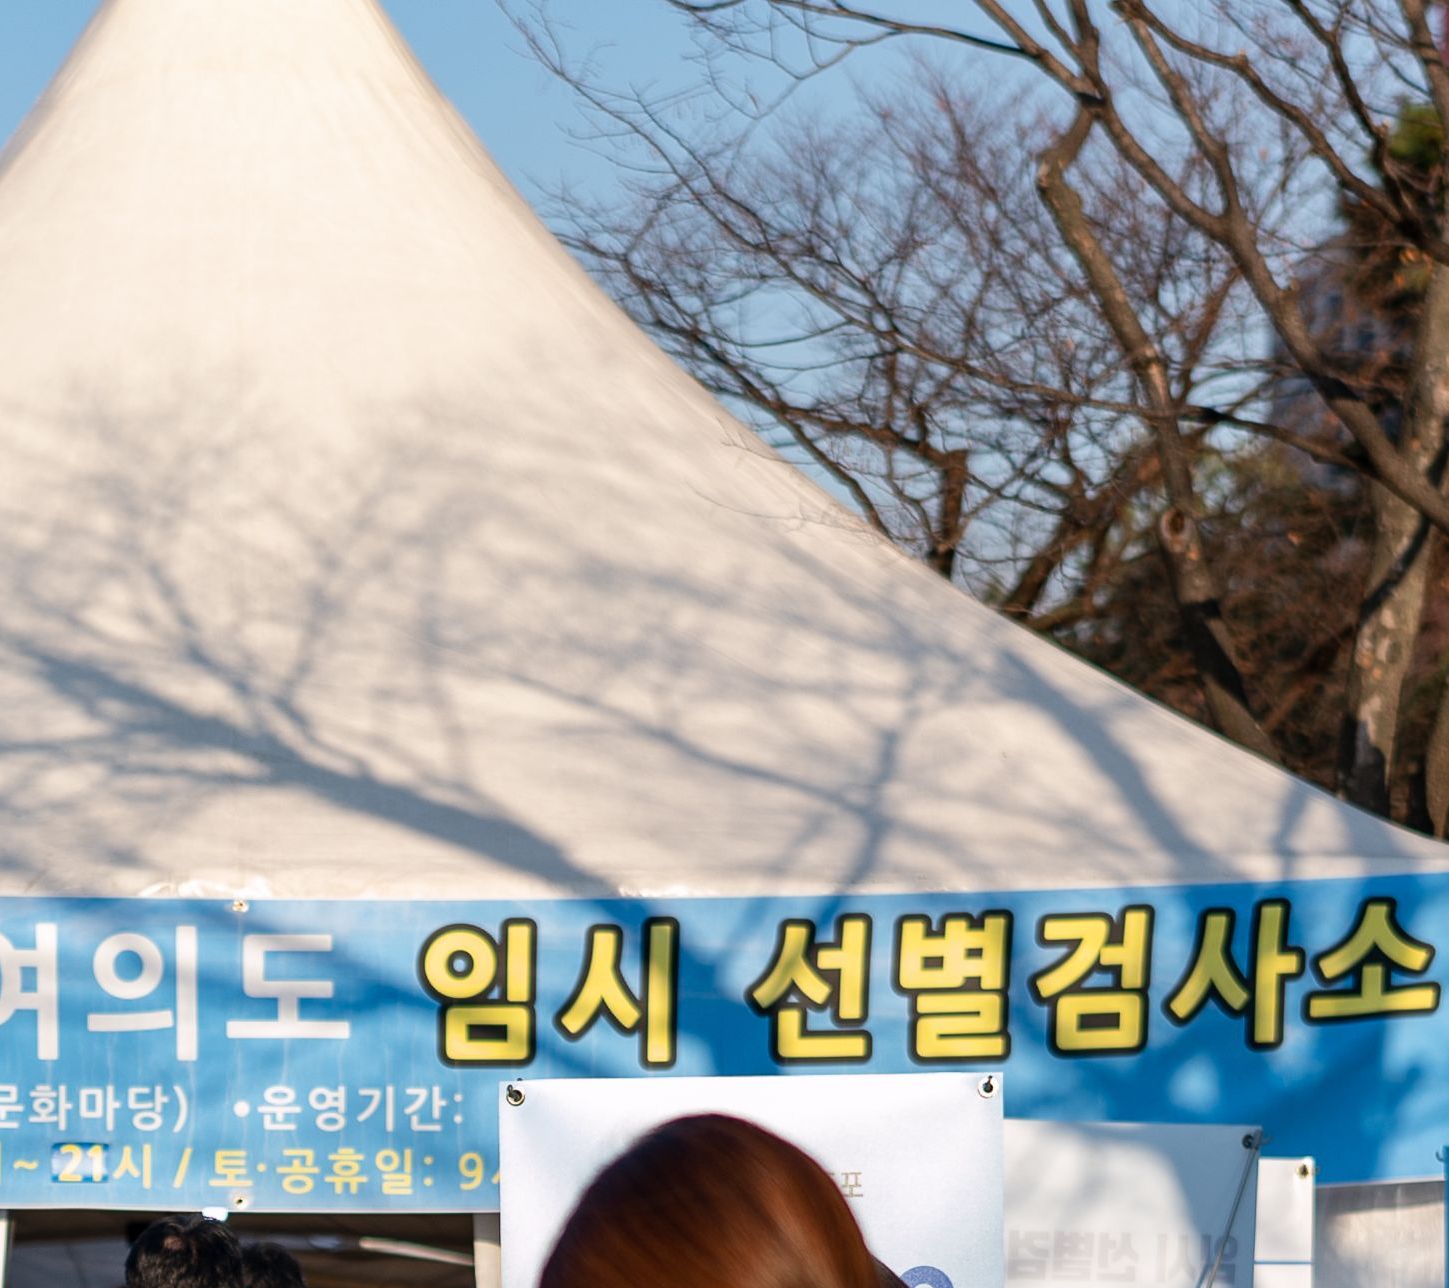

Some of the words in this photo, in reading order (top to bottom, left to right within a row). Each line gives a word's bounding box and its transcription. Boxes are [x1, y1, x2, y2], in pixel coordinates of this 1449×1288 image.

[418, 911, 679, 1069] 임시
[746, 897, 1442, 1066] 선별검사소
[257, 1086, 464, 1132] 운영기간:
